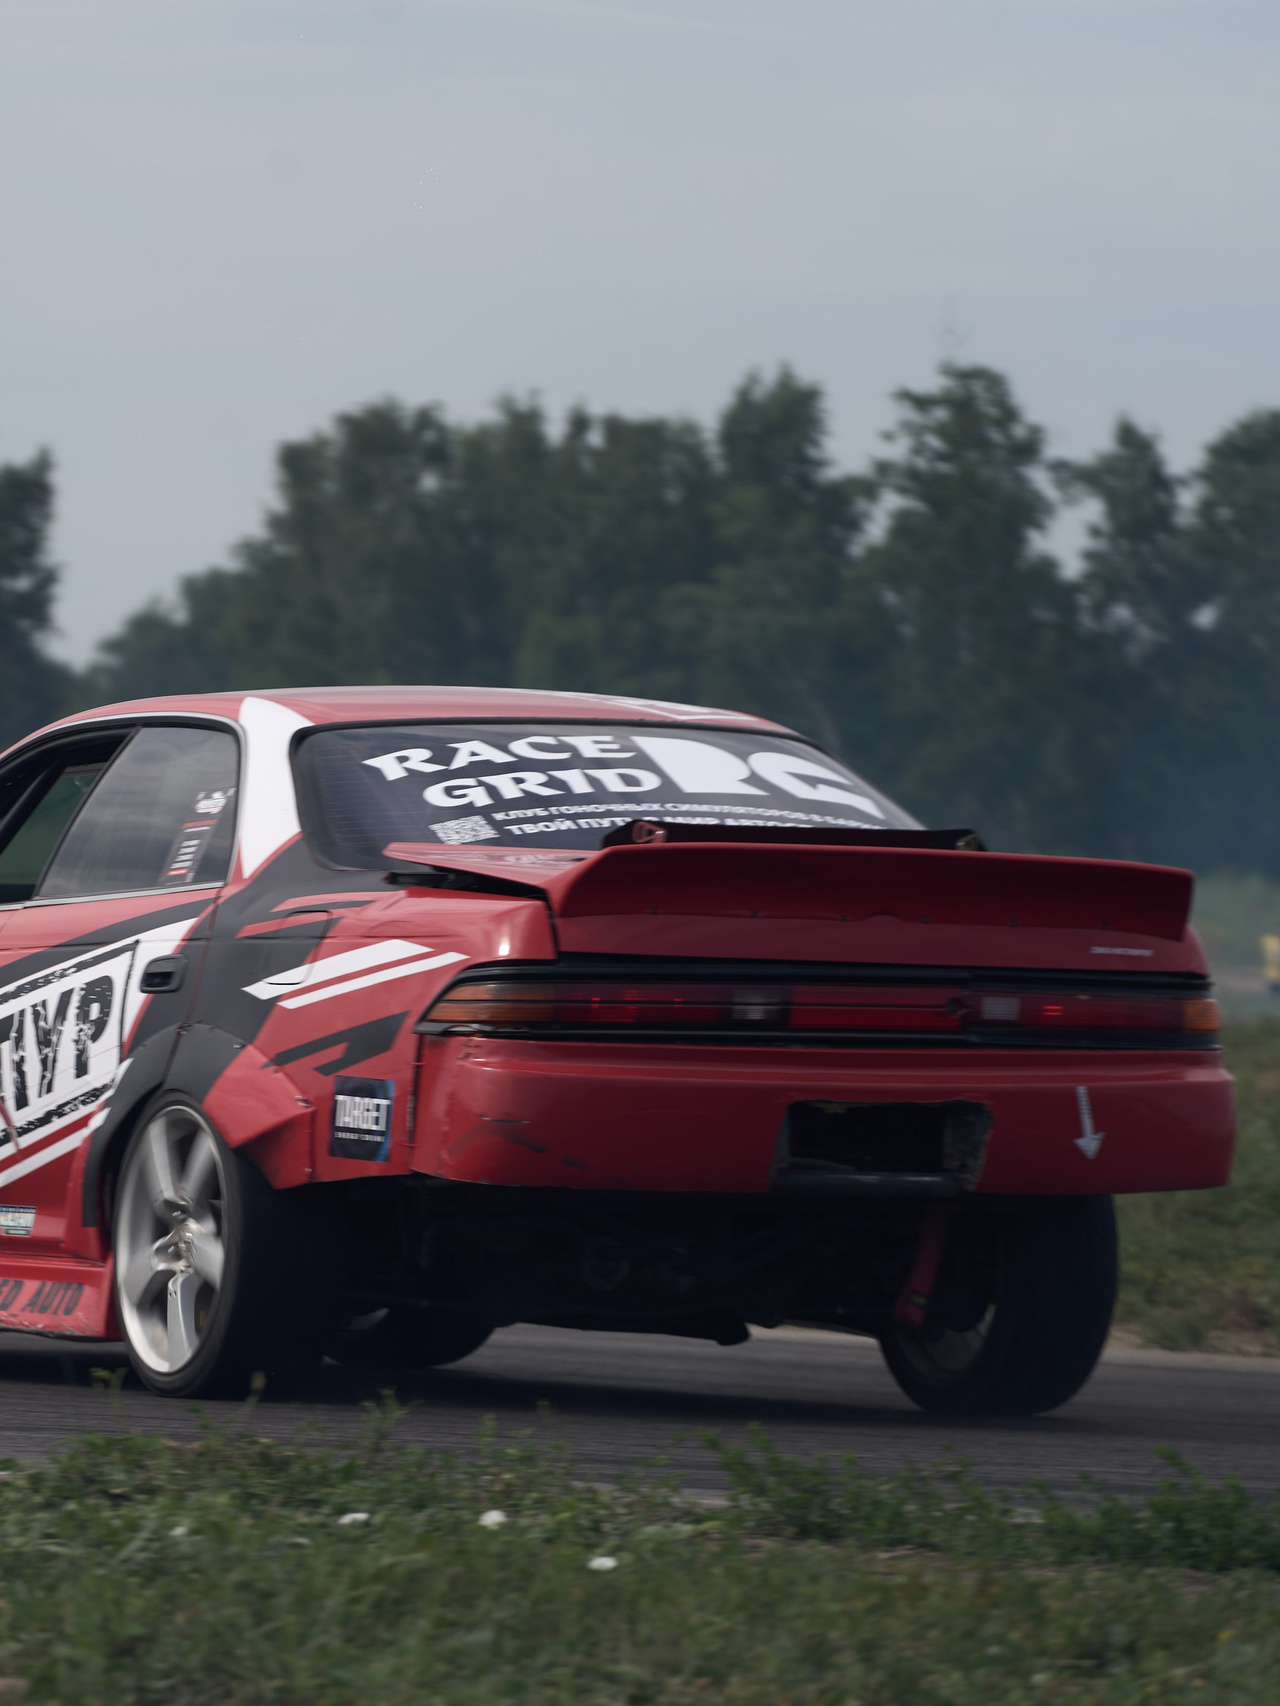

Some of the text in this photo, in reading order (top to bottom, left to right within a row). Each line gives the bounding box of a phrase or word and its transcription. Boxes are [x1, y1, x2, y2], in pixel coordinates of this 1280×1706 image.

[361, 735, 637, 781] RACE
[422, 768, 662, 808] GRID
[491, 808, 550, 820] КЛУБ
[503, 818, 579, 835] ТВОЙ
[334, 1094, 392, 1131] TARGET
[21, 1281, 84, 1316] AUTO
